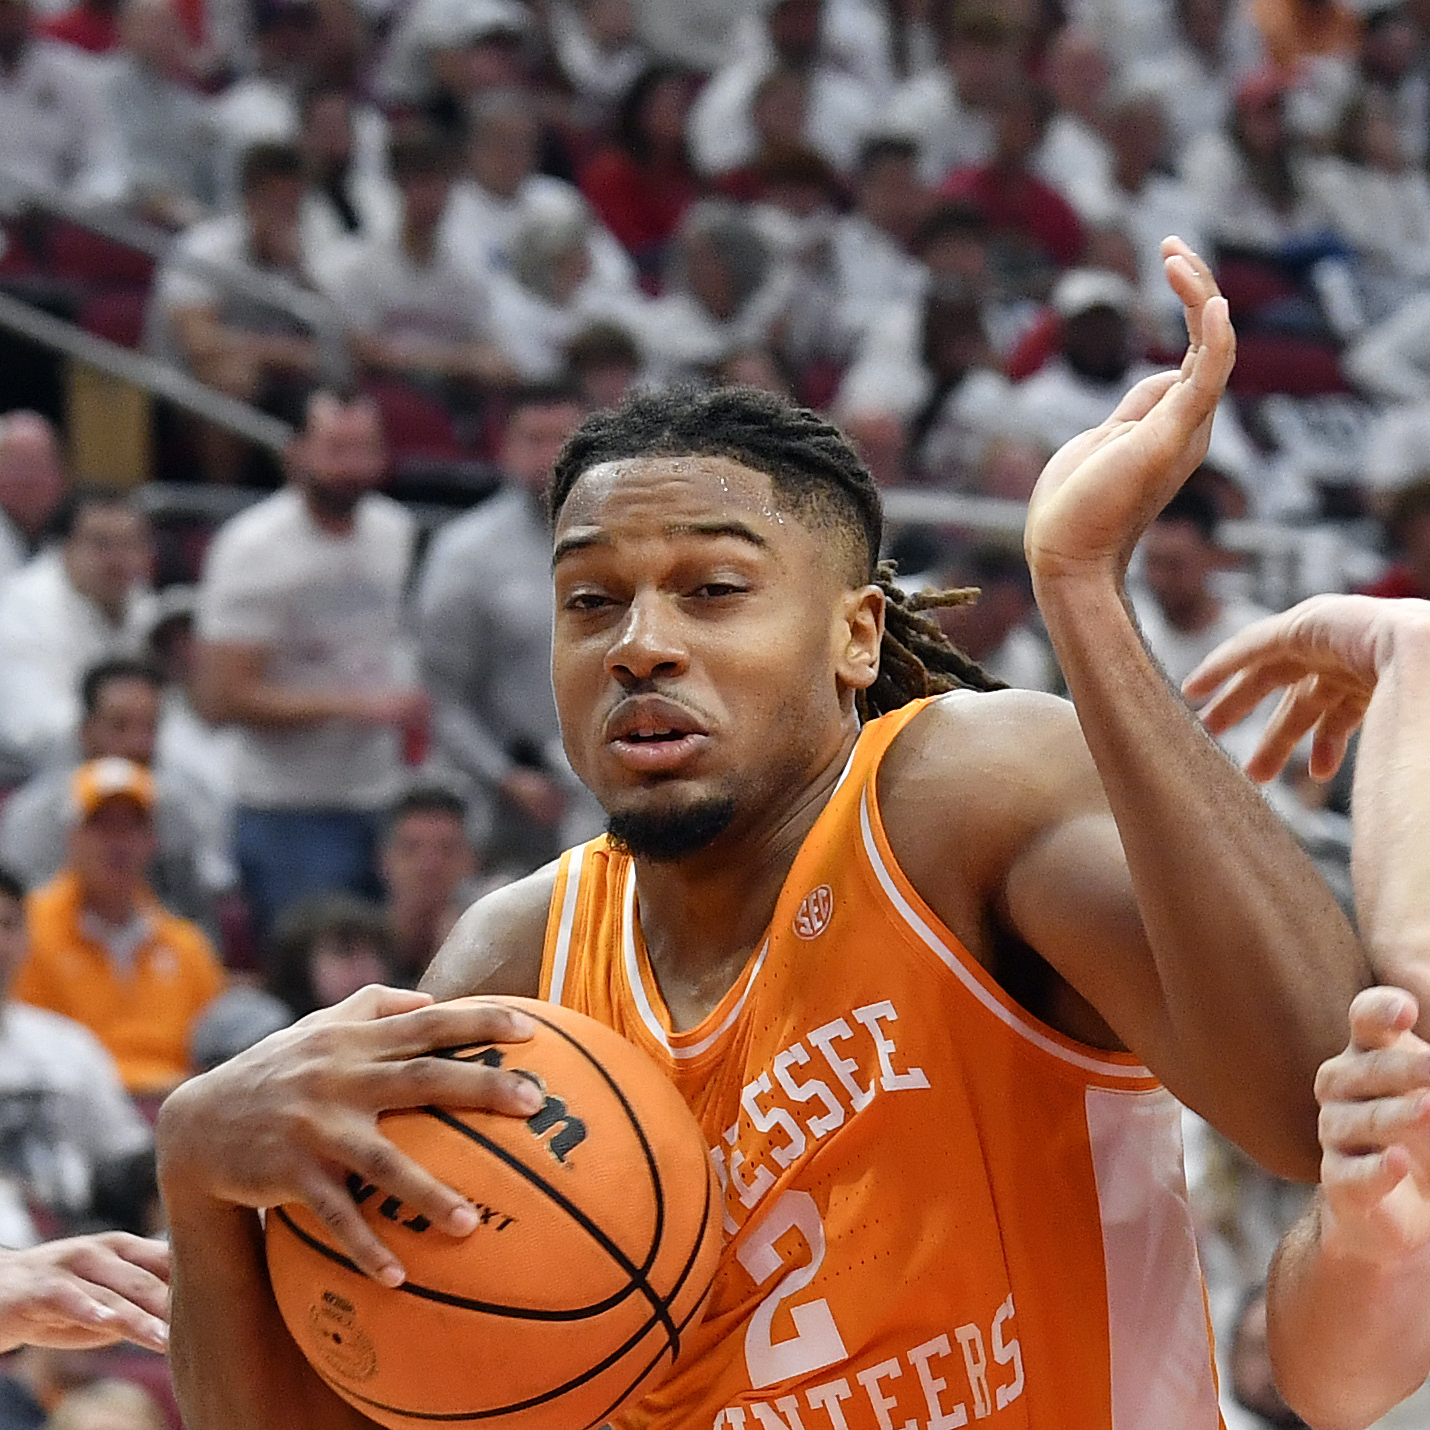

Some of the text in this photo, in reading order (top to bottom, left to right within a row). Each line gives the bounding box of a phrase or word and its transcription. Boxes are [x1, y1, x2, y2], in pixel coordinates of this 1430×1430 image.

[798, 888, 830, 934] SEC
[711, 1000, 931, 1235] ESSEE
[744, 1189, 849, 1390] 2
